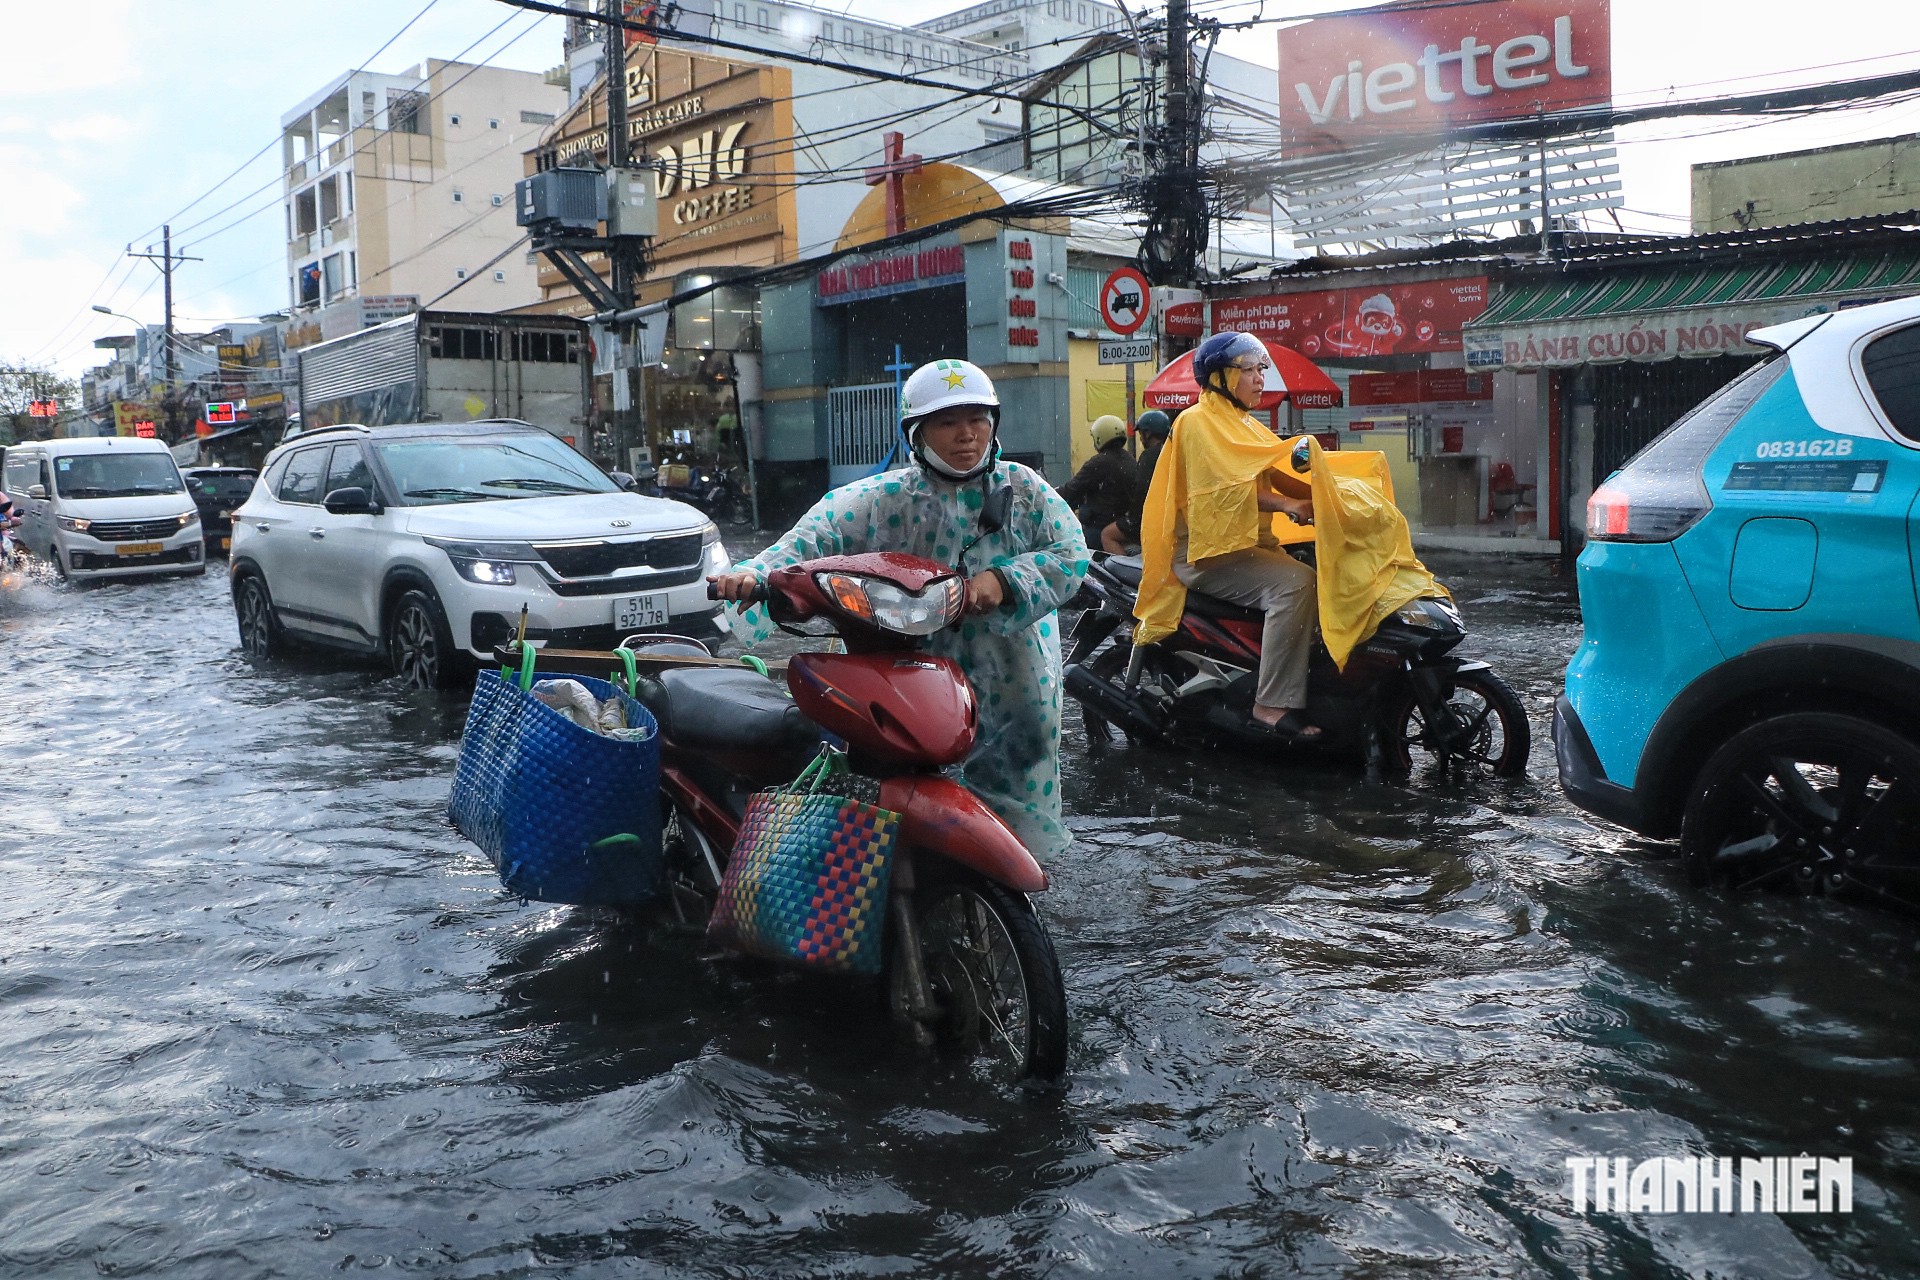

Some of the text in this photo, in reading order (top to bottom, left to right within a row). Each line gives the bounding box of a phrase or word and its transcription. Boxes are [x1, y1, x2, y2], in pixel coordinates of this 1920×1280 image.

[1295, 15, 1590, 124] viettel
[559, 131, 608, 161] SHOWRO
[654, 108, 667, 128] &
[667, 96, 702, 124] CAFE
[674, 185, 752, 225] COFFEE
[1450, 285, 1482, 295] viettel
[1246, 305, 1261, 318] phí
[1263, 304, 1288, 315] Data
[1503, 333, 1580, 364] BÁNH
[1587, 320, 1667, 358] CUỐN
[1102, 345, 1150, 359] 6:00-22:00
[1154, 393, 1190, 405] viettel
[1297, 394, 1333, 406] viettel
[1756, 439, 1853, 458] 083162B
[629, 597, 653, 611] 51H
[620, 610, 663, 627] 927.78
[1367, 646, 1398, 655] HONDA
